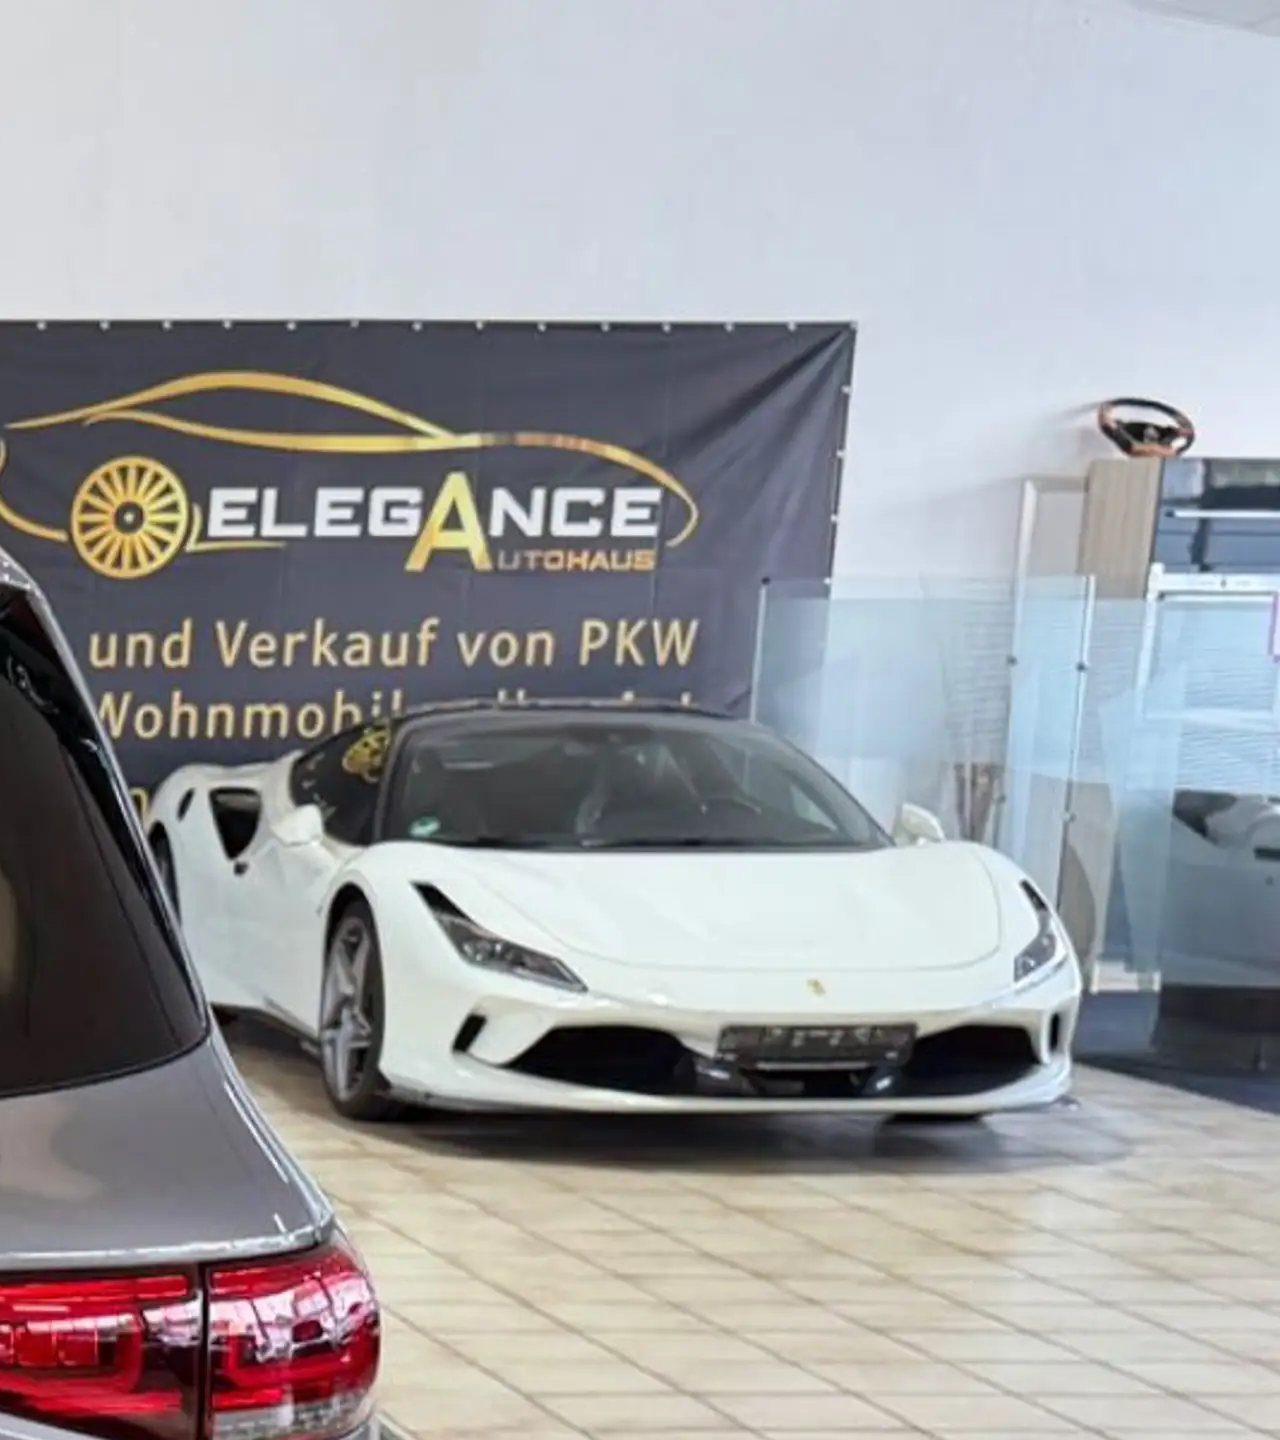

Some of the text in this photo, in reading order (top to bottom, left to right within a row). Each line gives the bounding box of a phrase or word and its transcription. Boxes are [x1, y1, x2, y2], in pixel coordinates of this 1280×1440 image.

[206, 471, 662, 571] ELEGANCE
[88, 618, 699, 668] und Verkauf von PKW
